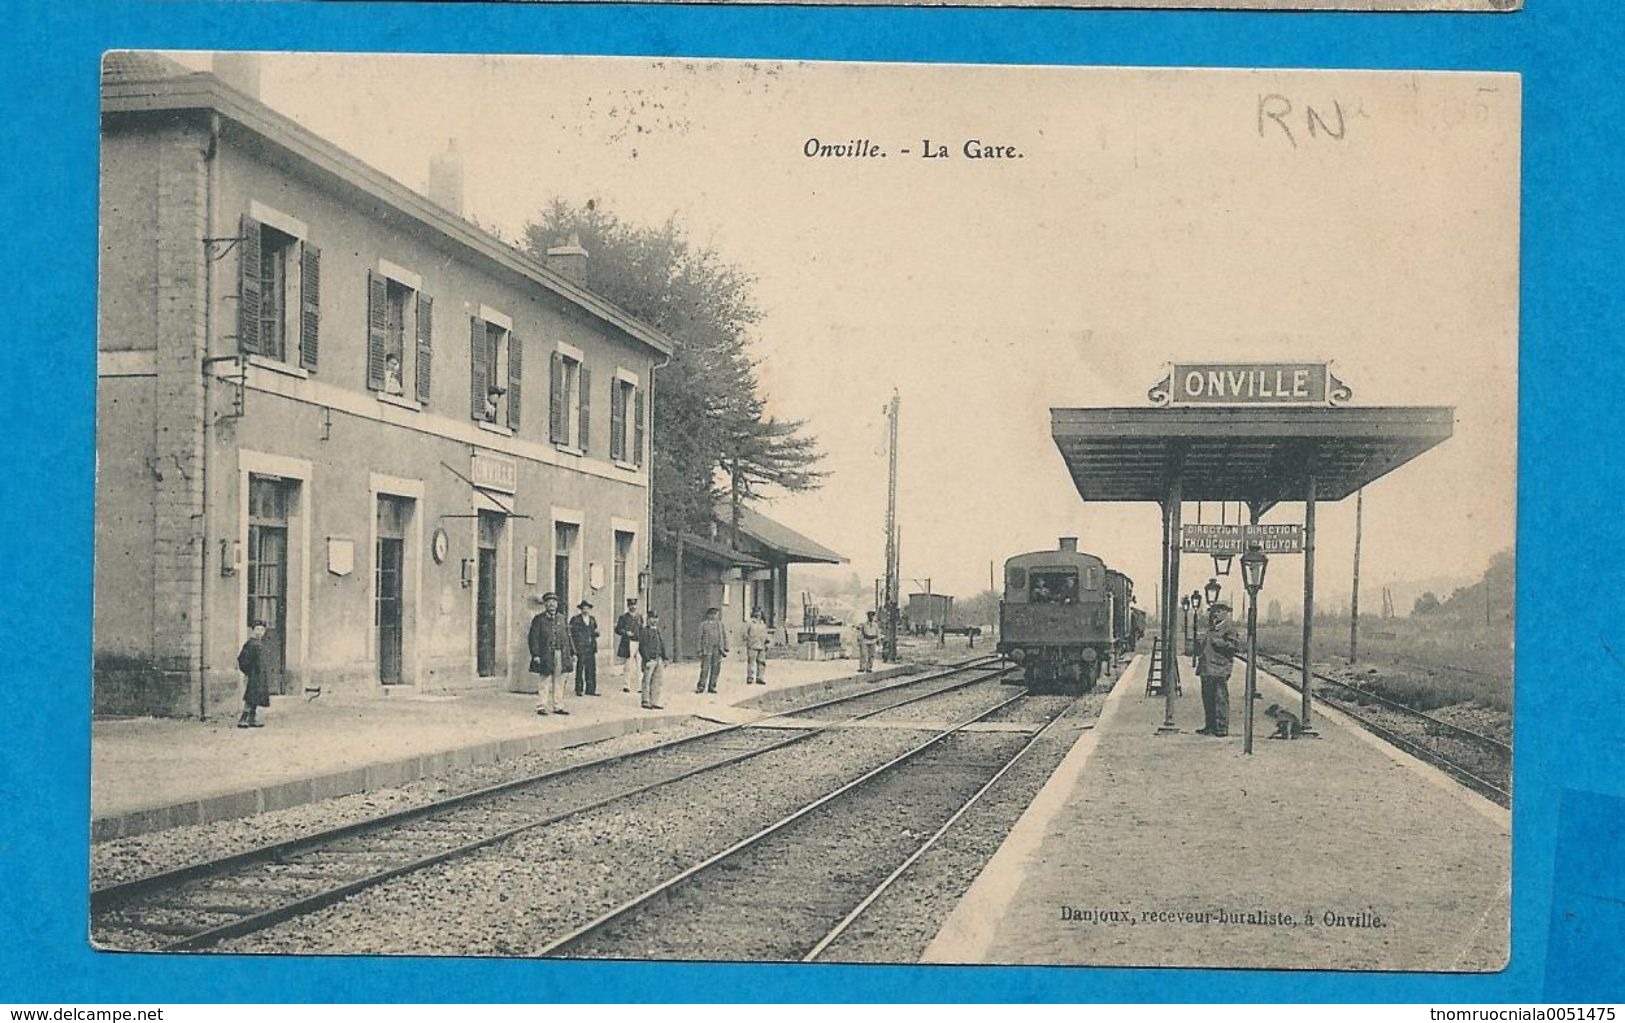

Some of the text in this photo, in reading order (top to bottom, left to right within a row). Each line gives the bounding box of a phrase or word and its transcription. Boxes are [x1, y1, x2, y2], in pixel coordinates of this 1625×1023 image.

[803, 138, 887, 158] Onville.
[922, 139, 949, 158] La
[963, 139, 1024, 159] Gare.
[1185, 370, 1309, 397] ONVILLE
[1187, 526, 1240, 535] DIRECTION
[1246, 526, 1298, 535] DIRECTION
[1184, 538, 1241, 549] THIAUCOURT
[1060, 906, 1136, 926] Danjoux,
[1141, 908, 1298, 928] receveur-buraliste,
[1323, 910, 1387, 928] Onville.
